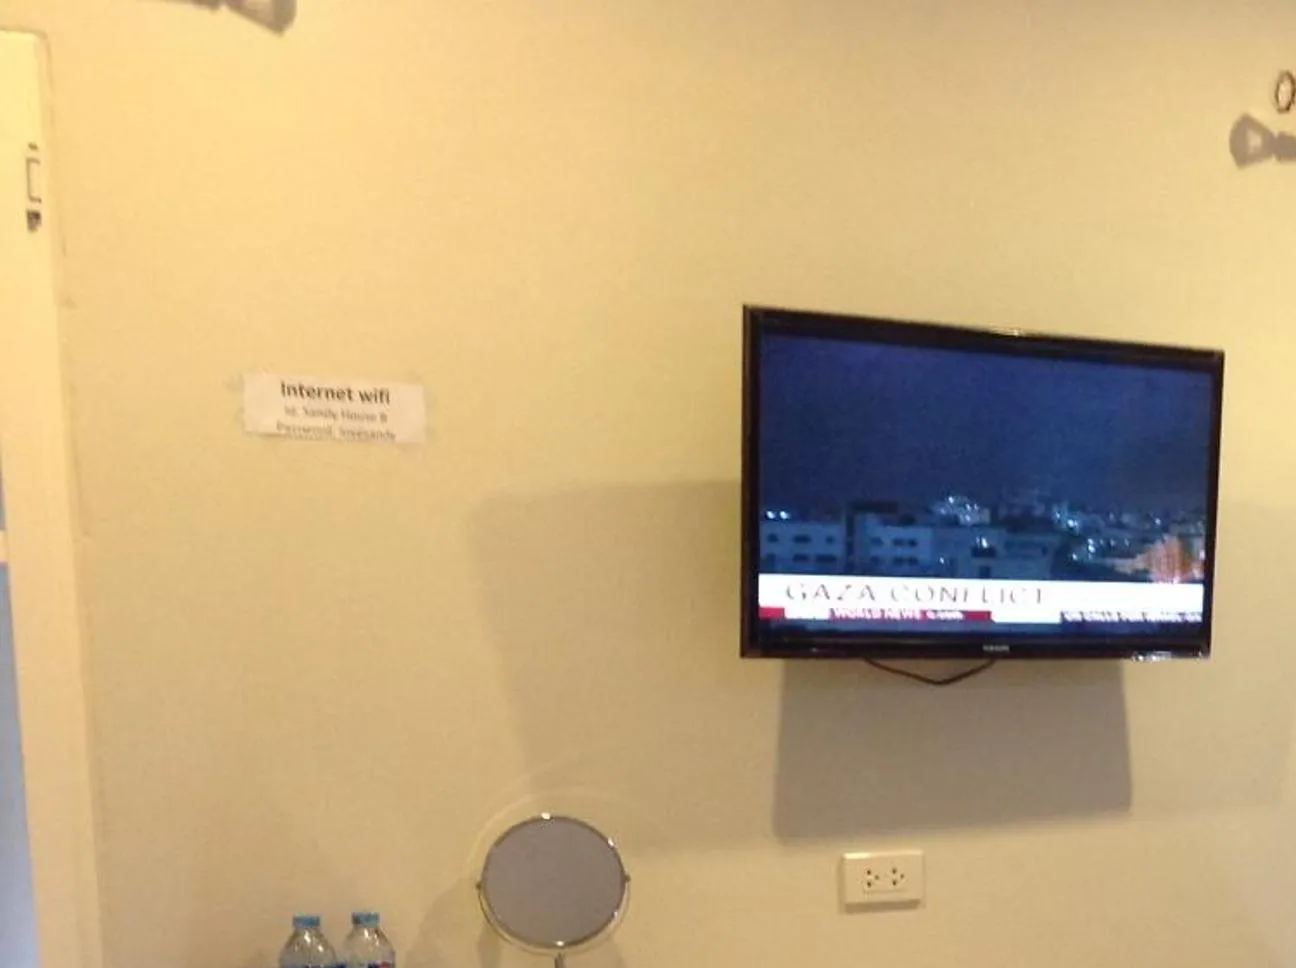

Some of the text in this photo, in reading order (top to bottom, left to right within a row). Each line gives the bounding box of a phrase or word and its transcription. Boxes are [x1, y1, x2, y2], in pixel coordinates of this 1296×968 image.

[281, 380, 390, 405] Internet wifi
[785, 583, 1045, 605] GAZA CONFLICT
